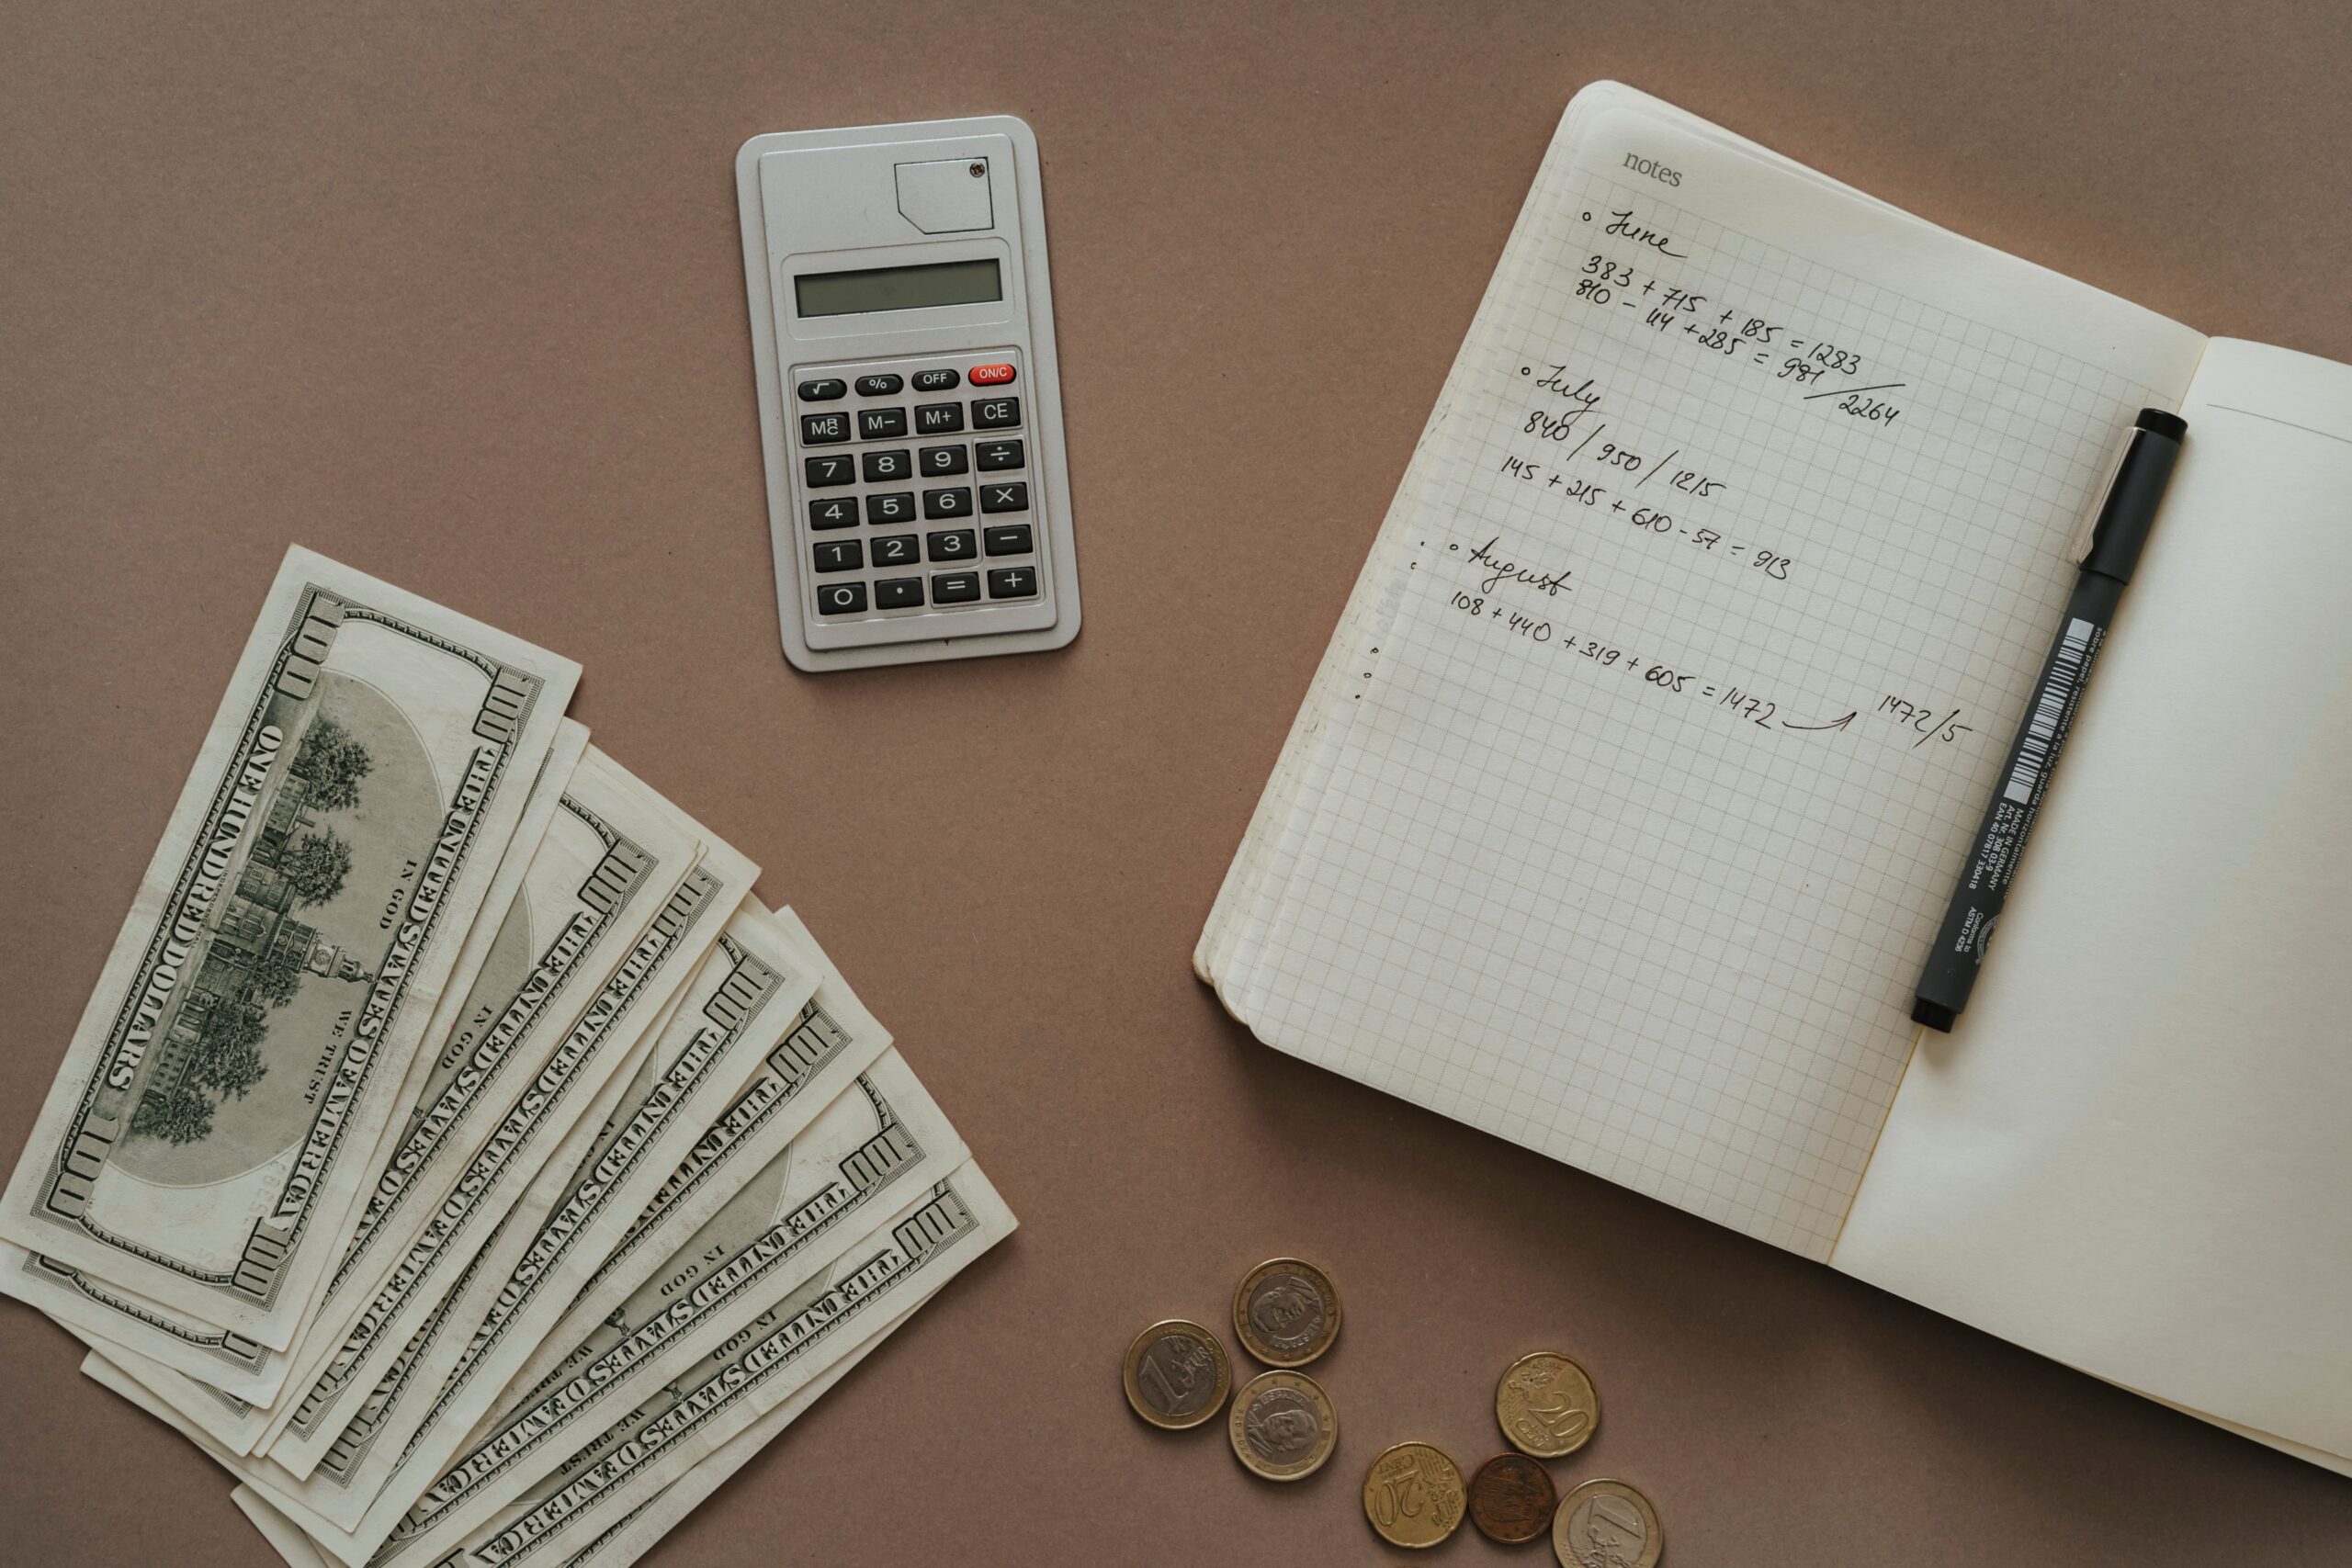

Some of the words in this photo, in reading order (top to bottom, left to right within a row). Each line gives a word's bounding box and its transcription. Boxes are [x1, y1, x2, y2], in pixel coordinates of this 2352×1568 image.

[1623, 150, 1683, 187] notes
[1606, 211, 1688, 258] June
[1576, 280, 1611, 304] 810
[1581, 255, 1631, 287] 383
[1662, 289, 1707, 312] 715
[1741, 319, 1783, 344] 185
[1808, 344, 1862, 374] 1283
[869, 379, 887, 389] %
[923, 373, 946, 385] OFF
[978, 367, 1007, 378] ON/C
[926, 411, 951, 424] M+
[984, 403, 1008, 419] CE
[1536, 366, 1604, 428] July
[1838, 395, 1900, 426] 2264
[822, 462, 837, 478] 7
[877, 457, 895, 472] 8
[935, 452, 952, 468] 9
[1523, 412, 1569, 441] 840
[1597, 443, 1641, 472] 950
[1670, 469, 1725, 498] 1215
[824, 504, 842, 519] 4
[883, 499, 899, 514] 5
[939, 493, 956, 509] 6
[1501, 456, 1539, 480] 145
[1632, 507, 1671, 533] 610
[1692, 527, 1721, 549] 57
[831, 547, 842, 561] 1
[887, 541, 904, 557] 2
[944, 536, 961, 551] 3
[1470, 536, 1571, 596] August
[1004, 573, 1022, 587] +
[272, 593, 347, 703] 100
[1452, 592, 1484, 615] 108
[1509, 615, 1551, 641] 440
[1645, 665, 1695, 693] 605
[1720, 687, 1777, 729] 1472
[2088, 626, 2103, 653] sobre
[2075, 654, 2093, 684] papel,
[471, 666, 533, 746] 100
[2059, 685, 2080, 731] resistente
[234, 720, 286, 796] ONE
[2051, 741, 2061, 751] la
[453, 745, 498, 815] THE
[2030, 771, 2048, 806] guarda
[1989, 820, 1999, 832] 40
[1994, 801, 2007, 820] EAN
[1997, 822, 2008, 835] Nr.
[2003, 805, 2016, 821] Art.
[2007, 807, 2024, 835] MADE
[1979, 832, 1996, 858] 07817
[1984, 852, 1997, 871] 03-9
[1992, 835, 2004, 852] 308
[2001, 806, 2036, 886] horizontalmente
[2003, 835, 2013, 845] IN
[169, 786, 256, 945] HUNDRED
[398, 858, 418, 882] IN
[404, 808, 469, 925] UNITED
[575, 838, 648, 916] 100
[1967, 859, 1985, 889] 330418
[1986, 846, 2009, 891] GERMANY
[376, 886, 406, 932] GOD
[1961, 927, 1969, 935] D
[1962, 905, 1977, 928] ASTM
[1965, 910, 1984, 944] Conforms
[540, 909, 598, 976] THE
[1962, 944, 1971, 953] to
[353, 919, 423, 1043] STATES
[605, 933, 662, 999] THE
[105, 939, 190, 1093] DOLLARS
[470, 1004, 492, 1028] IN
[702, 954, 773, 1032] 100
[330, 1007, 352, 1038] WE
[468, 964, 557, 1073] UNITED
[334, 1035, 372, 1086] OF
[438, 1029, 474, 1071] GOD
[533, 988, 620, 1097] UNITED
[662, 1026, 720, 1092] THE
[764, 1010, 842, 1085] 100
[300, 1041, 337, 1105] TRUST
[390, 1064, 483, 1176] STATES
[718, 1075, 784, 1137] THE
[275, 1071, 356, 1222] AMERICA
[455, 1088, 546, 1200] STATES
[588, 1078, 679, 1187] UNITED
[46, 1106, 123, 1220] 100
[837, 1122, 916, 1194] 100
[783, 1180, 850, 1237] THE
[890, 1190, 969, 1261] 100
[509, 1177, 603, 1289] STATES
[701, 1243, 726, 1266] IN
[230, 1216, 293, 1299] 100
[658, 1262, 699, 1298] GOD
[686, 1221, 796, 1310] UNITED
[835, 1247, 903, 1304] THE
[339, 1222, 446, 1357] AMERICA
[582, 1296, 696, 1389] STATES
[738, 1288, 848, 1375] UNITED
[754, 1309, 777, 1330] IN
[563, 1343, 594, 1369] WE
[709, 1326, 752, 1362] GOD
[543, 1373, 594, 1418] OF
[633, 1361, 748, 1453] STATES
[1527, 1390, 1589, 1438] 20
[612, 1405, 646, 1435] WE
[422, 1397, 562, 1509] AMERICA
[556, 1429, 615, 1476] TRUST
[594, 1437, 644, 1482] OF
[471, 1459, 613, 1568] AMERICA
[1376, 1470, 1424, 1527] 20
